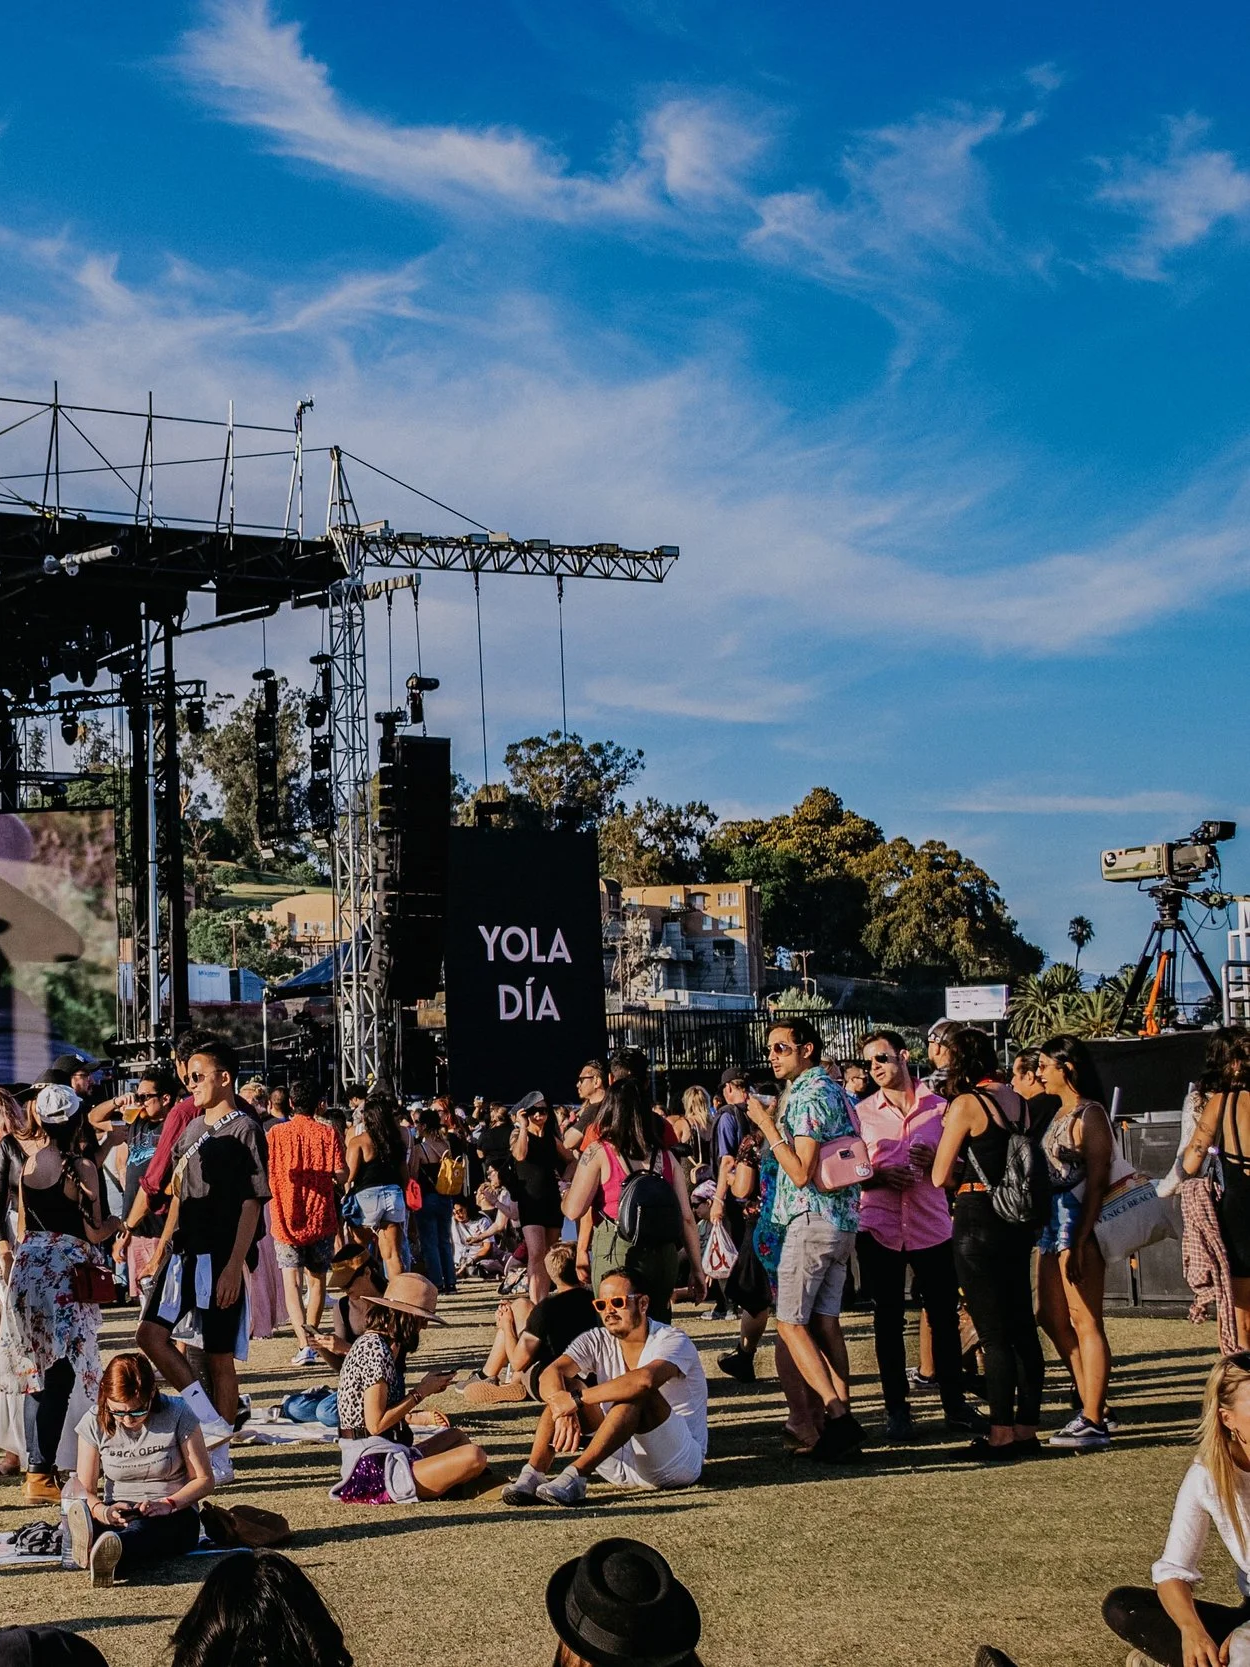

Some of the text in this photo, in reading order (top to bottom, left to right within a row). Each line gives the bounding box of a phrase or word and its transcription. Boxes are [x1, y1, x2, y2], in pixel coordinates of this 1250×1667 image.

[477, 925, 573, 963] YOLA
[498, 976, 561, 1021] DÍA
[1127, 1190, 1157, 1209] BEACH
